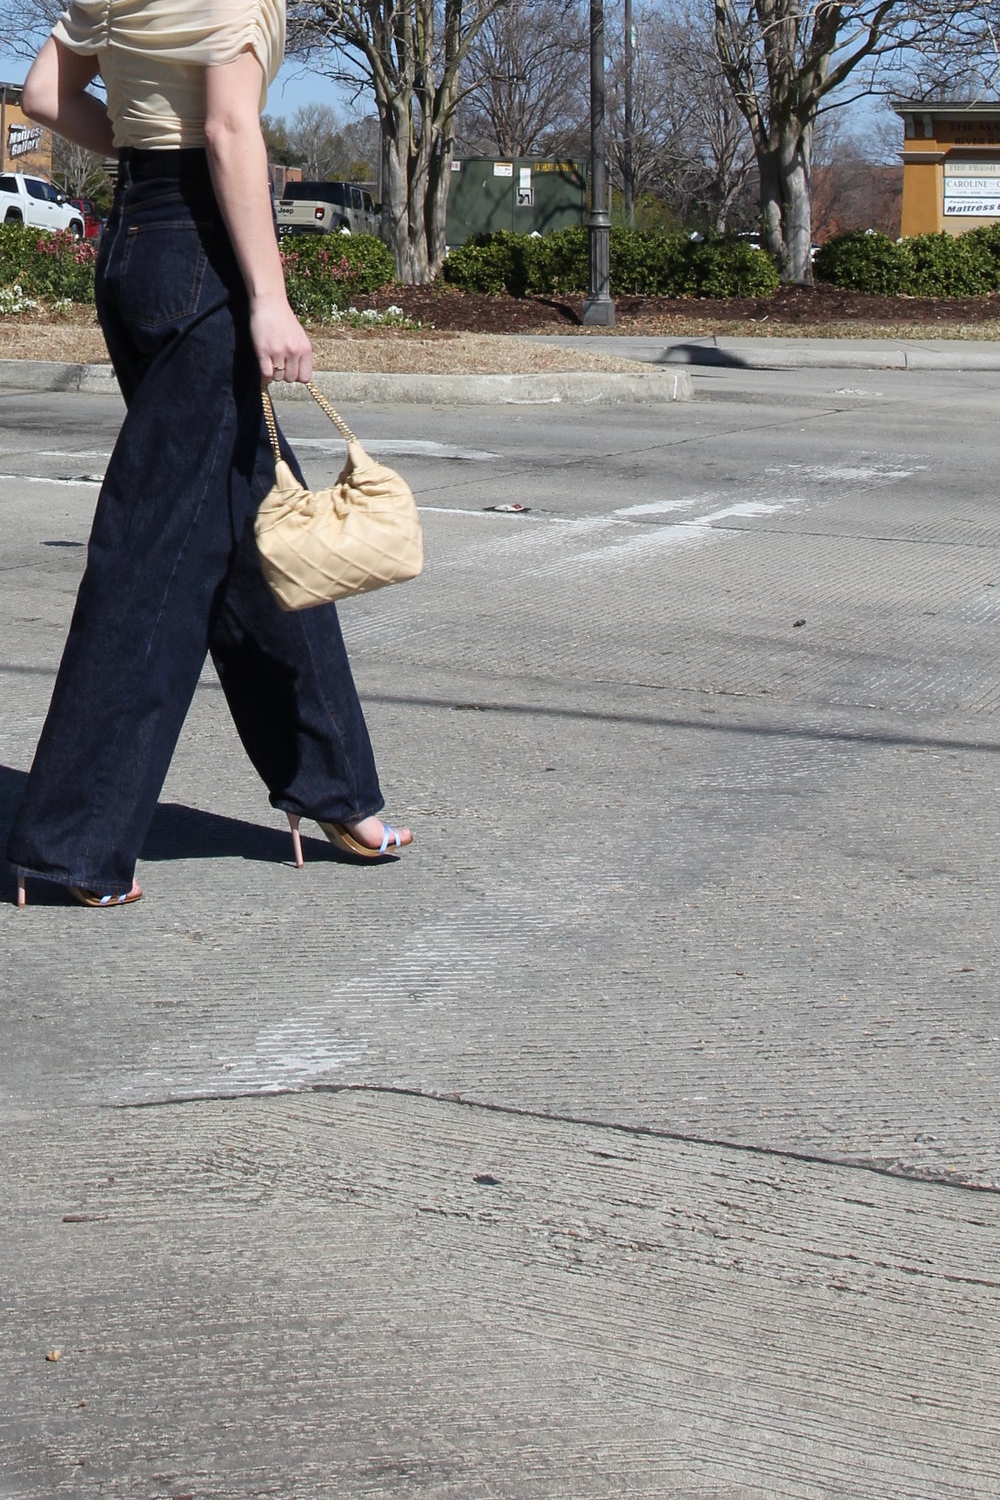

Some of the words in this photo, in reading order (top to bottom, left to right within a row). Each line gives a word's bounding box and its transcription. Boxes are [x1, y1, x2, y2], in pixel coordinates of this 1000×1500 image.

[11, 137, 40, 157] Gallery
[968, 164, 996, 172] FRESH
[946, 180, 987, 188] CAROLINE
[278, 207, 294, 215] Jeep
[946, 203, 995, 213] Mattress
